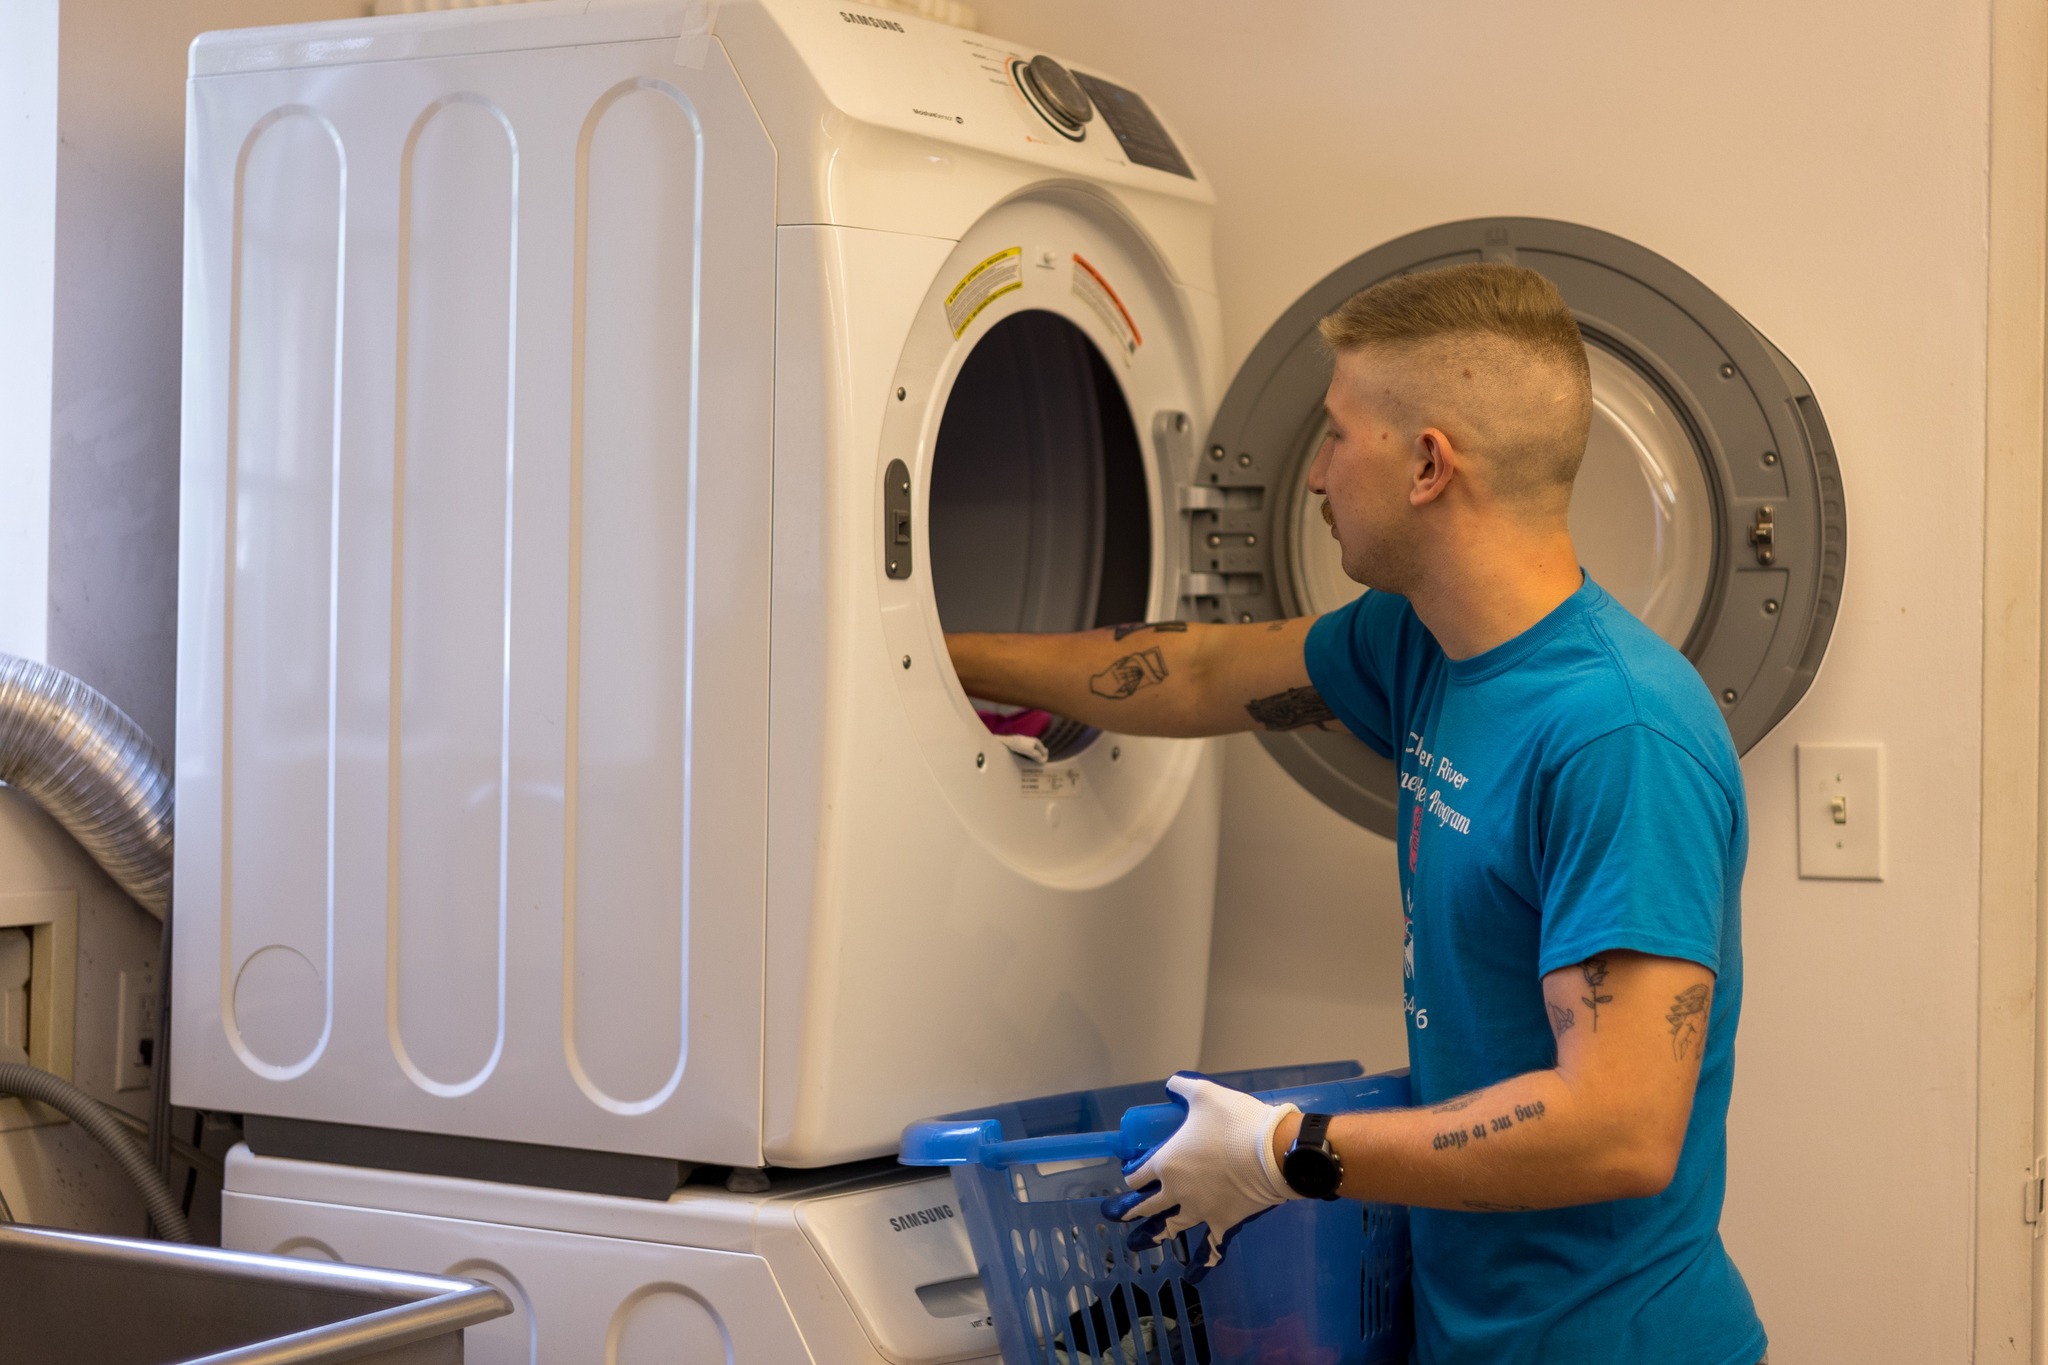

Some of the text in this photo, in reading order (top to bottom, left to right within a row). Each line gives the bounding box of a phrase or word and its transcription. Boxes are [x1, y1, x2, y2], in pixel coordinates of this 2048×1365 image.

[840, 11, 905, 34] SAMSUNG
[1436, 756, 1469, 790] River
[1428, 789, 1471, 835] Program
[1433, 1100, 1546, 1150] sing me to sleep
[889, 1204, 954, 1232] SAMSUNG
